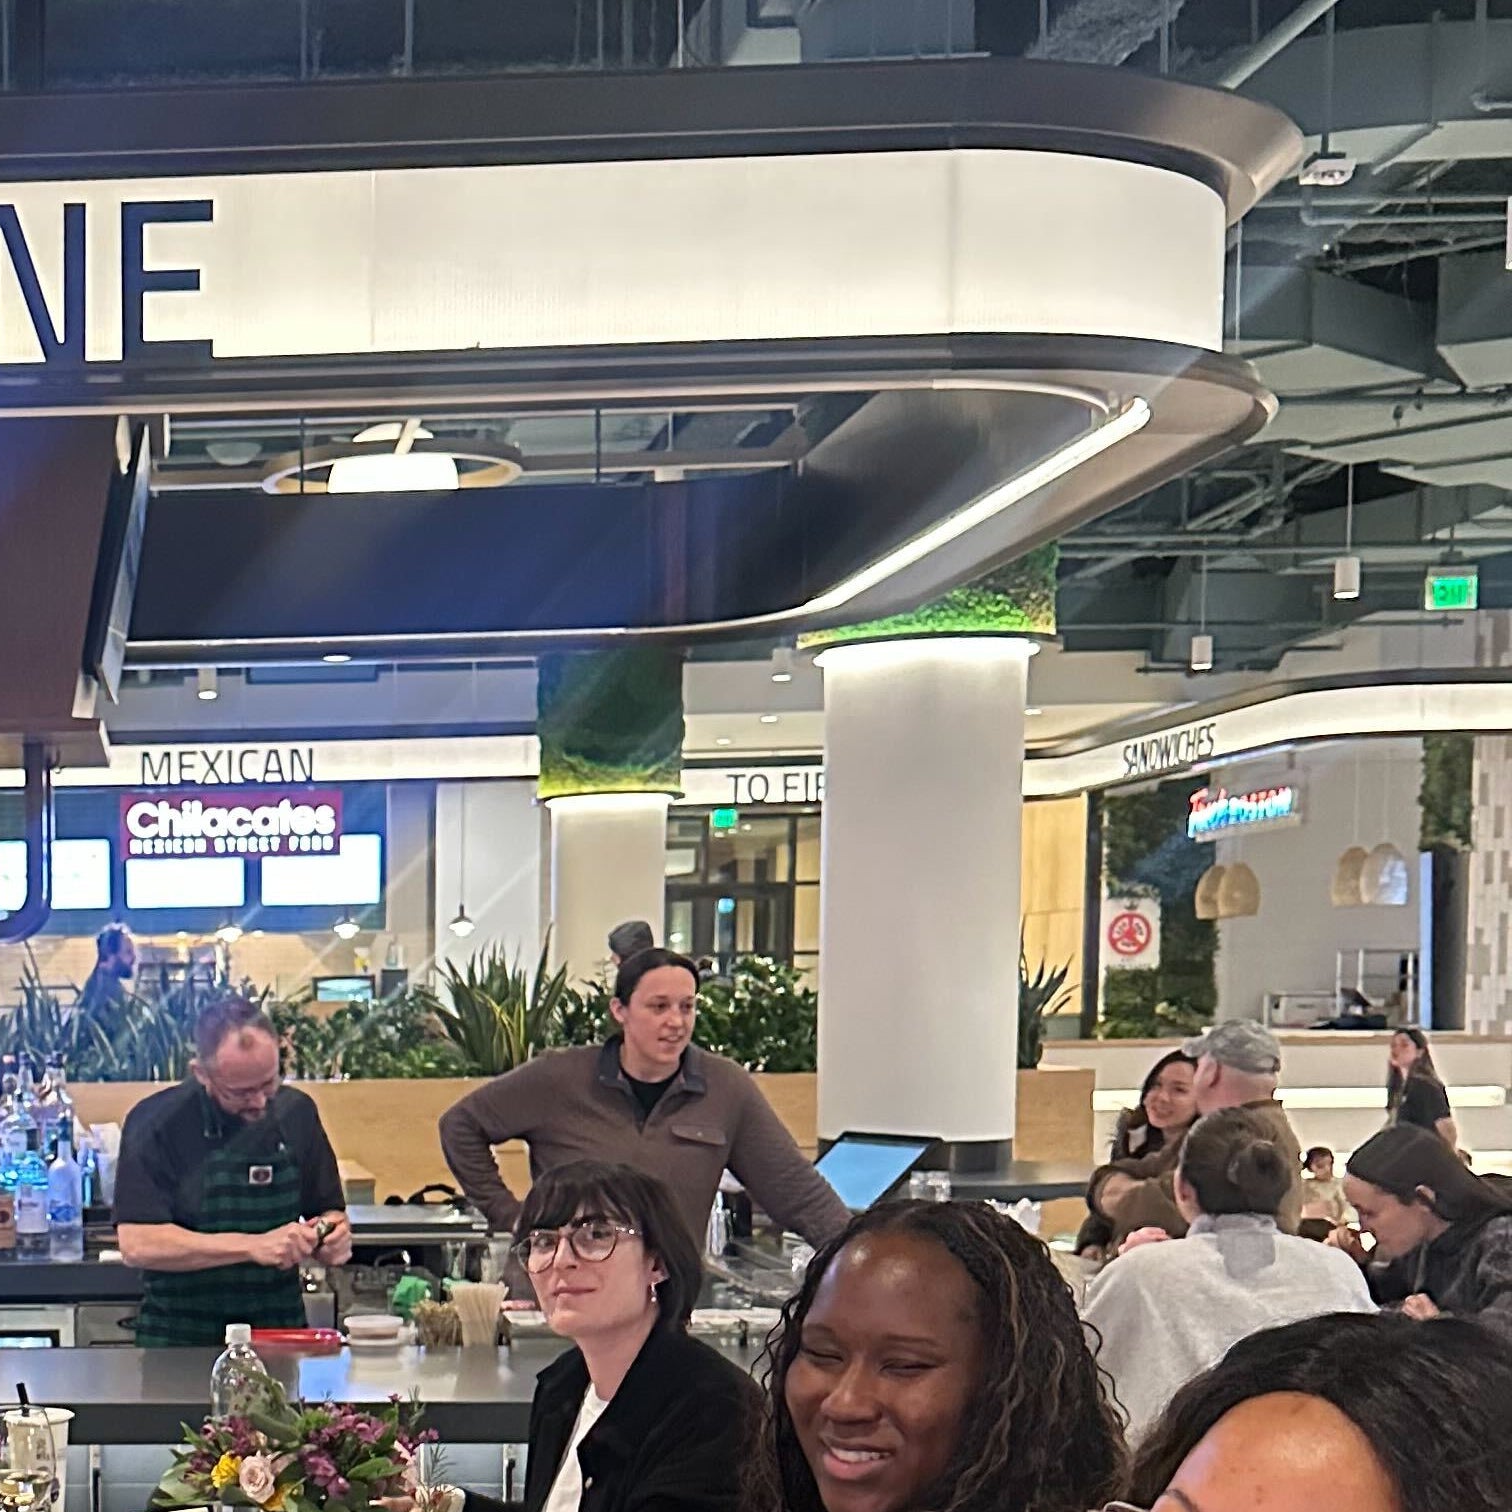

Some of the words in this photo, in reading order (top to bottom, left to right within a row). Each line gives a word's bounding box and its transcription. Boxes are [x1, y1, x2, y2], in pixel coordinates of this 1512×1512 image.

[141, 748, 314, 786] MEXICAN
[1122, 723, 1217, 778] SANDWICHES
[726, 772, 770, 804] TO
[126, 797, 337, 839] Chilacates
